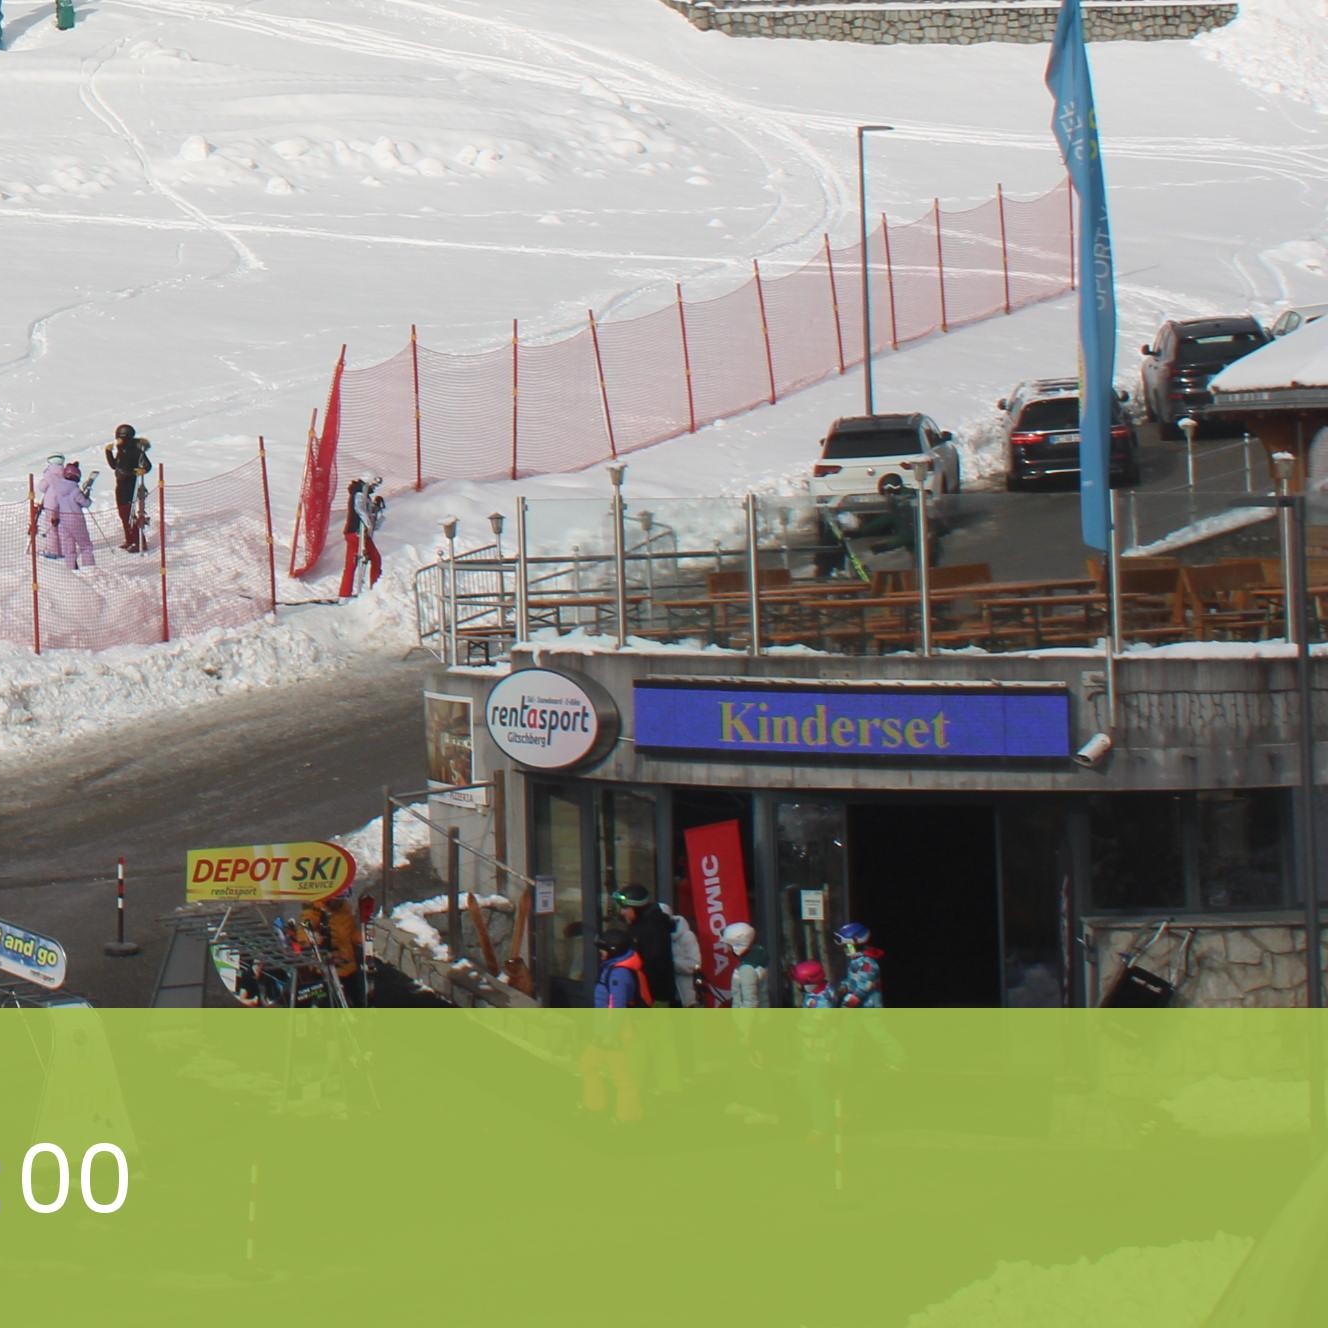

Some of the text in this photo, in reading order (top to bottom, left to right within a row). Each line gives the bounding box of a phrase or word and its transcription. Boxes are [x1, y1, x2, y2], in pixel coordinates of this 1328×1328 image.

[491, 695, 590, 746] rentasport
[717, 700, 951, 749] Kinderset
[507, 731, 546, 748] Gitschberg
[192, 856, 342, 884] DEPOT SKI
[297, 880, 334, 890] SERVICE
[4, 933, 35, 958] and
[36, 946, 59, 967] go
